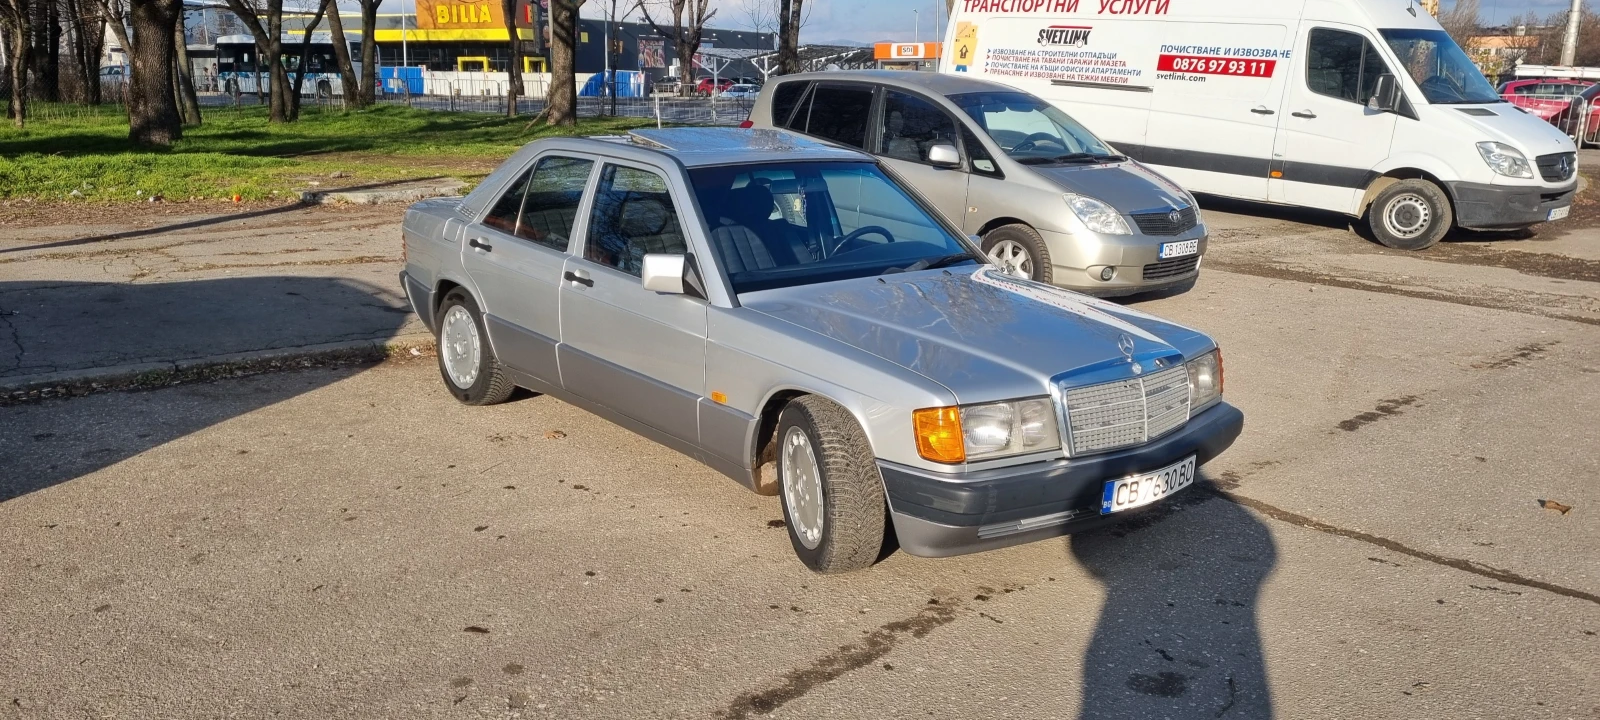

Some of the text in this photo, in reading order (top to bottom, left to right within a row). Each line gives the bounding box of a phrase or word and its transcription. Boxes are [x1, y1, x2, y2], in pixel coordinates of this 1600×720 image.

[436, 4, 492, 24] BILLA
[964, 0, 1170, 15] ТРАНСПОРТНИ УСЛУГИ
[1037, 29, 1091, 46] SVETLINK
[993, 48, 1027, 57] ИЗВОЗВАНЕ
[1037, 50, 1078, 59] СТРОИТЕЛНИ
[1079, 51, 1117, 60] ОТПАДЪЦИ
[1160, 44, 1292, 58] ПОЧИСТВАНЕ И ИЗВОЗВАНЕ
[992, 54, 1030, 63] ПОЧИСТВАНЕ
[1041, 57, 1065, 65] ТАВАНИ
[1067, 58, 1093, 66] ГАРАЖИ
[1173, 57, 1266, 75] 0876 97 93 11
[990, 68, 1023, 77] ПРЕНАСЯНЕ
[1030, 71, 1065, 79] ИЗВОЗВАНЕ
[1077, 74, 1099, 82] ТЕЖКИ
[1100, 76, 1129, 84] МЕБЕЛИ
[991, 61, 1030, 70] ПОЧИСТВАНЕ
[1040, 64, 1059, 72] КЪЩИ
[1060, 65, 1083, 73] ОФИСИ
[1091, 67, 1142, 77] АПАРТАМЕНТИ
[1156, 72, 1206, 82] svetlink.com
[1165, 244, 1173, 256] CB
[1103, 500, 1112, 508] BG
[1116, 480, 1139, 506] CB
[1142, 468, 1178, 500] 7630
